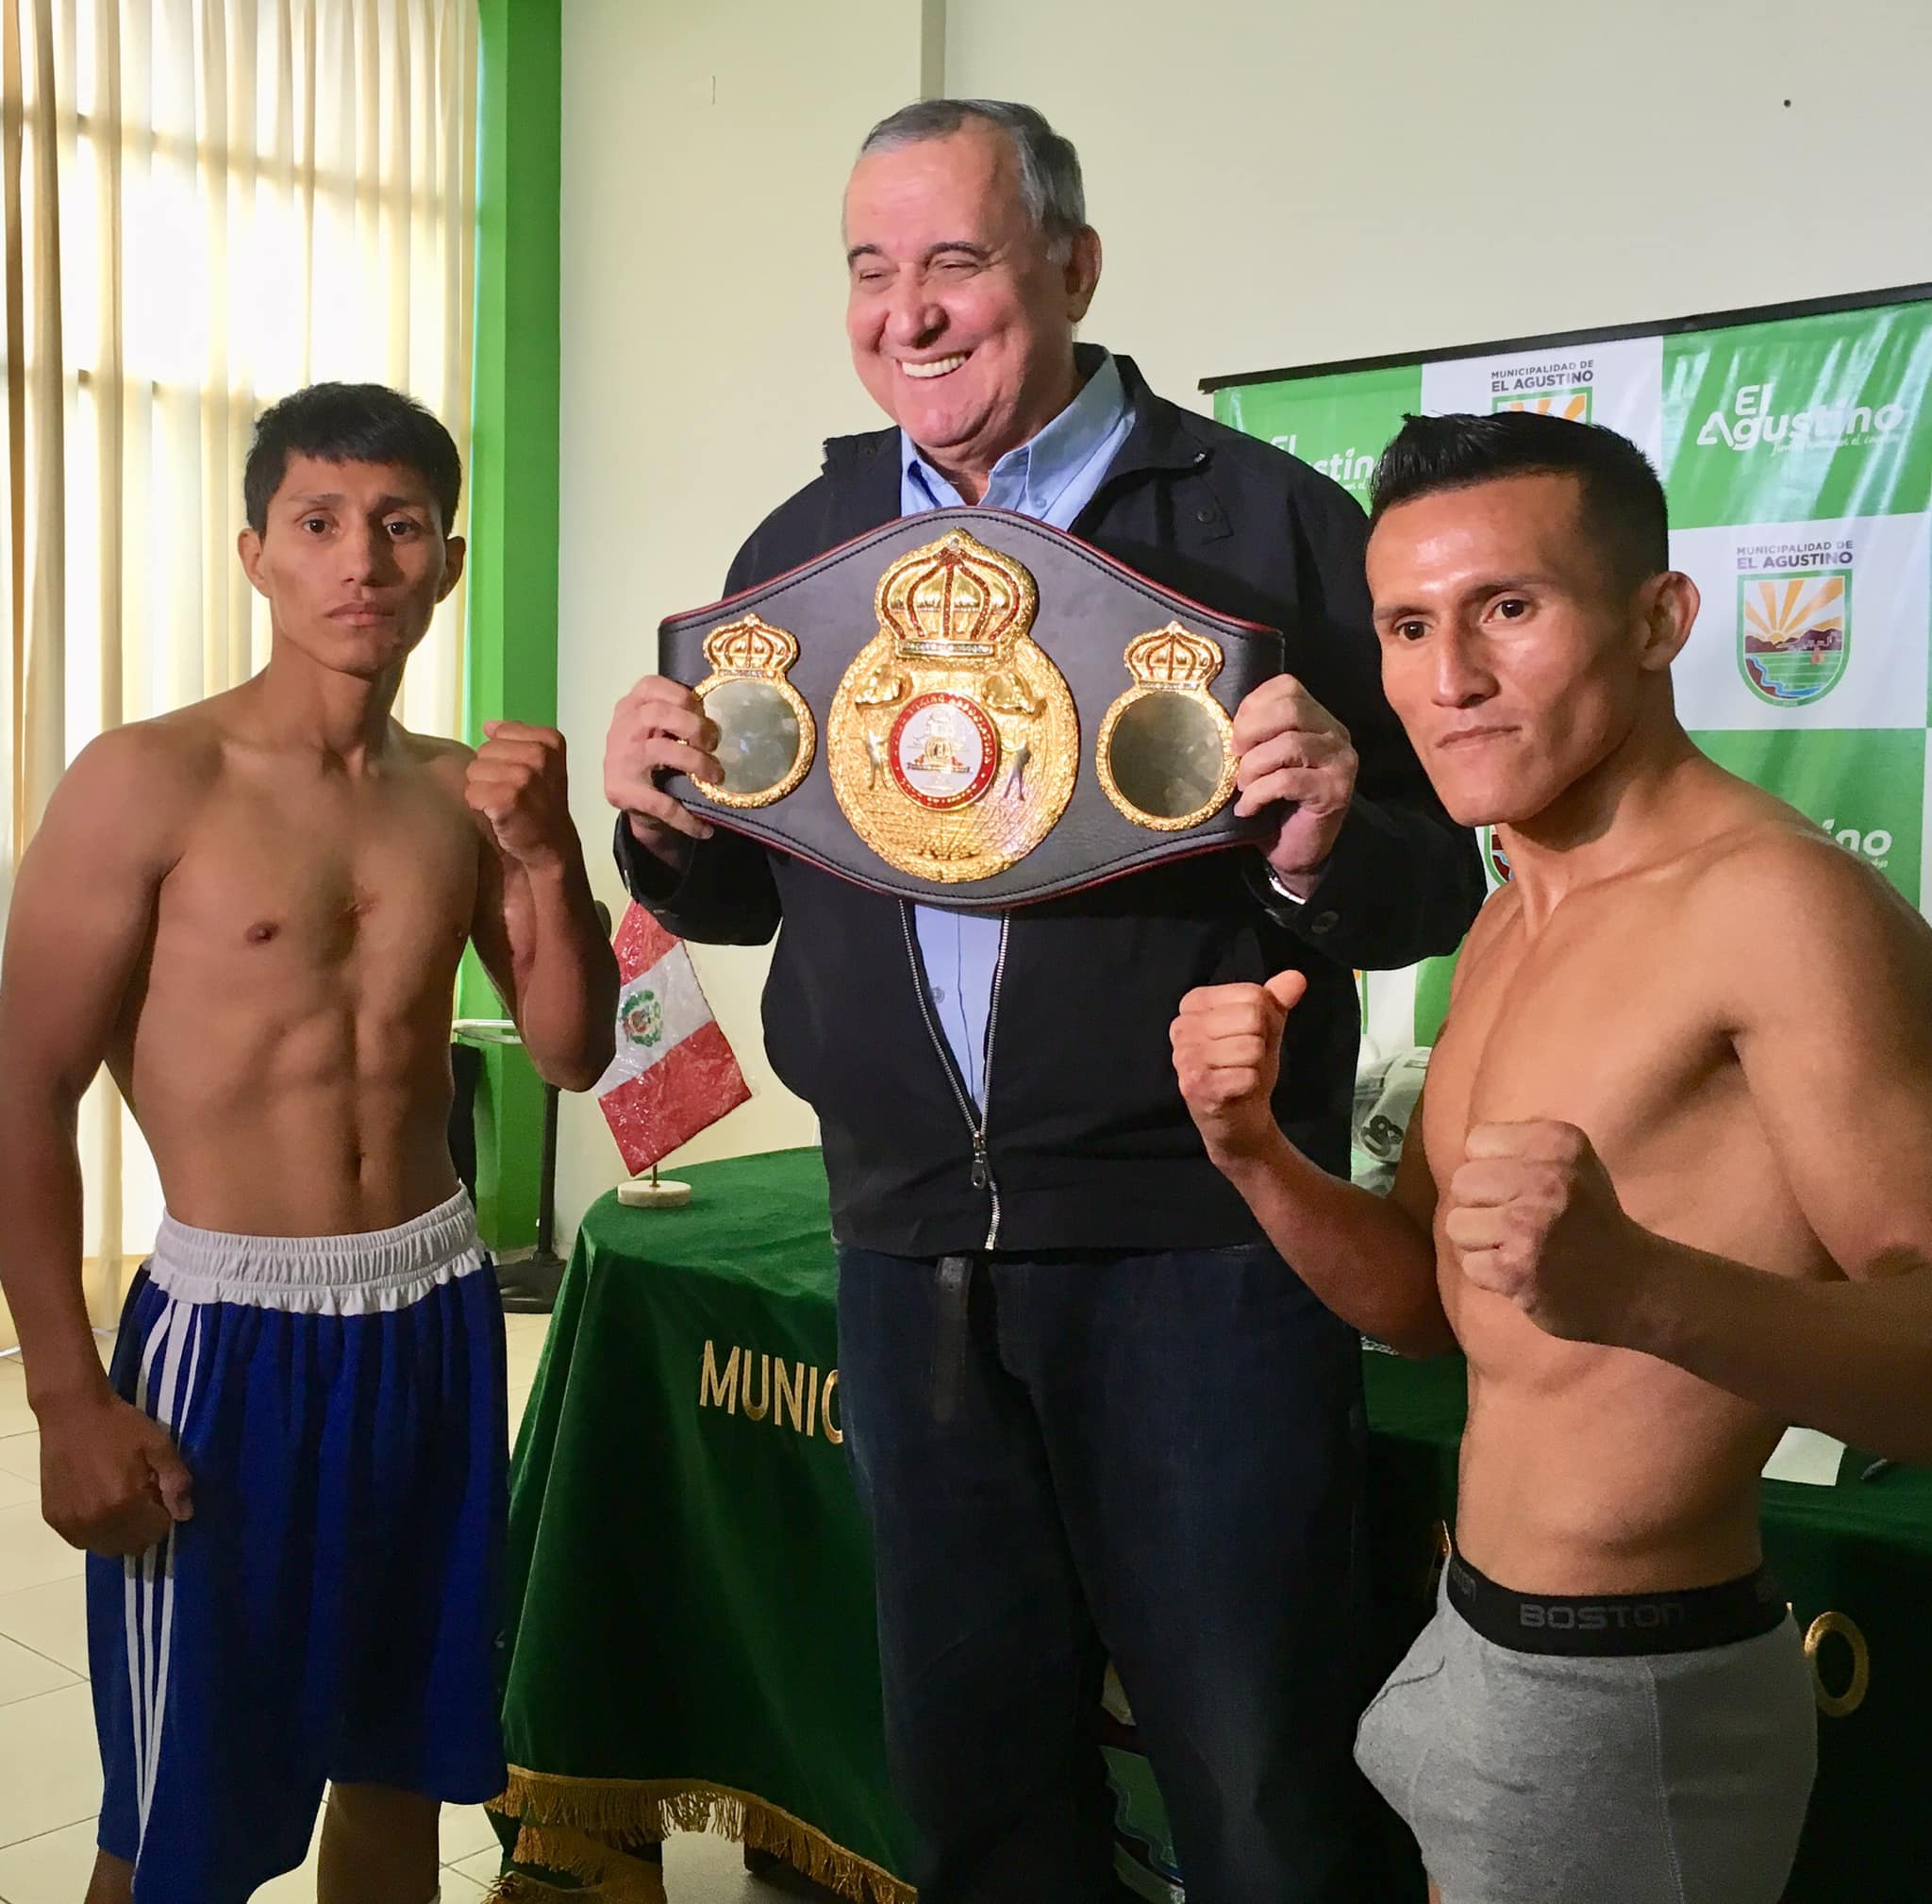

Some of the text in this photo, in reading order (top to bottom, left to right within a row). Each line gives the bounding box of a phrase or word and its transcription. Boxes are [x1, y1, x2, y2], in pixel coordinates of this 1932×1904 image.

[1491, 359, 1594, 379] MUNICIPALIDAD DE
[1491, 370, 1594, 392] EL AGUSTINO
[1735, 383, 1774, 416] El
[1309, 447, 1374, 482] stin
[1737, 540, 1854, 555] MUNICIPALIDAD DE
[1737, 552, 1854, 570] EL AGUSTINO
[1520, 1602, 1684, 1630] BOSTON
[1786, 1602, 1869, 1717] O
